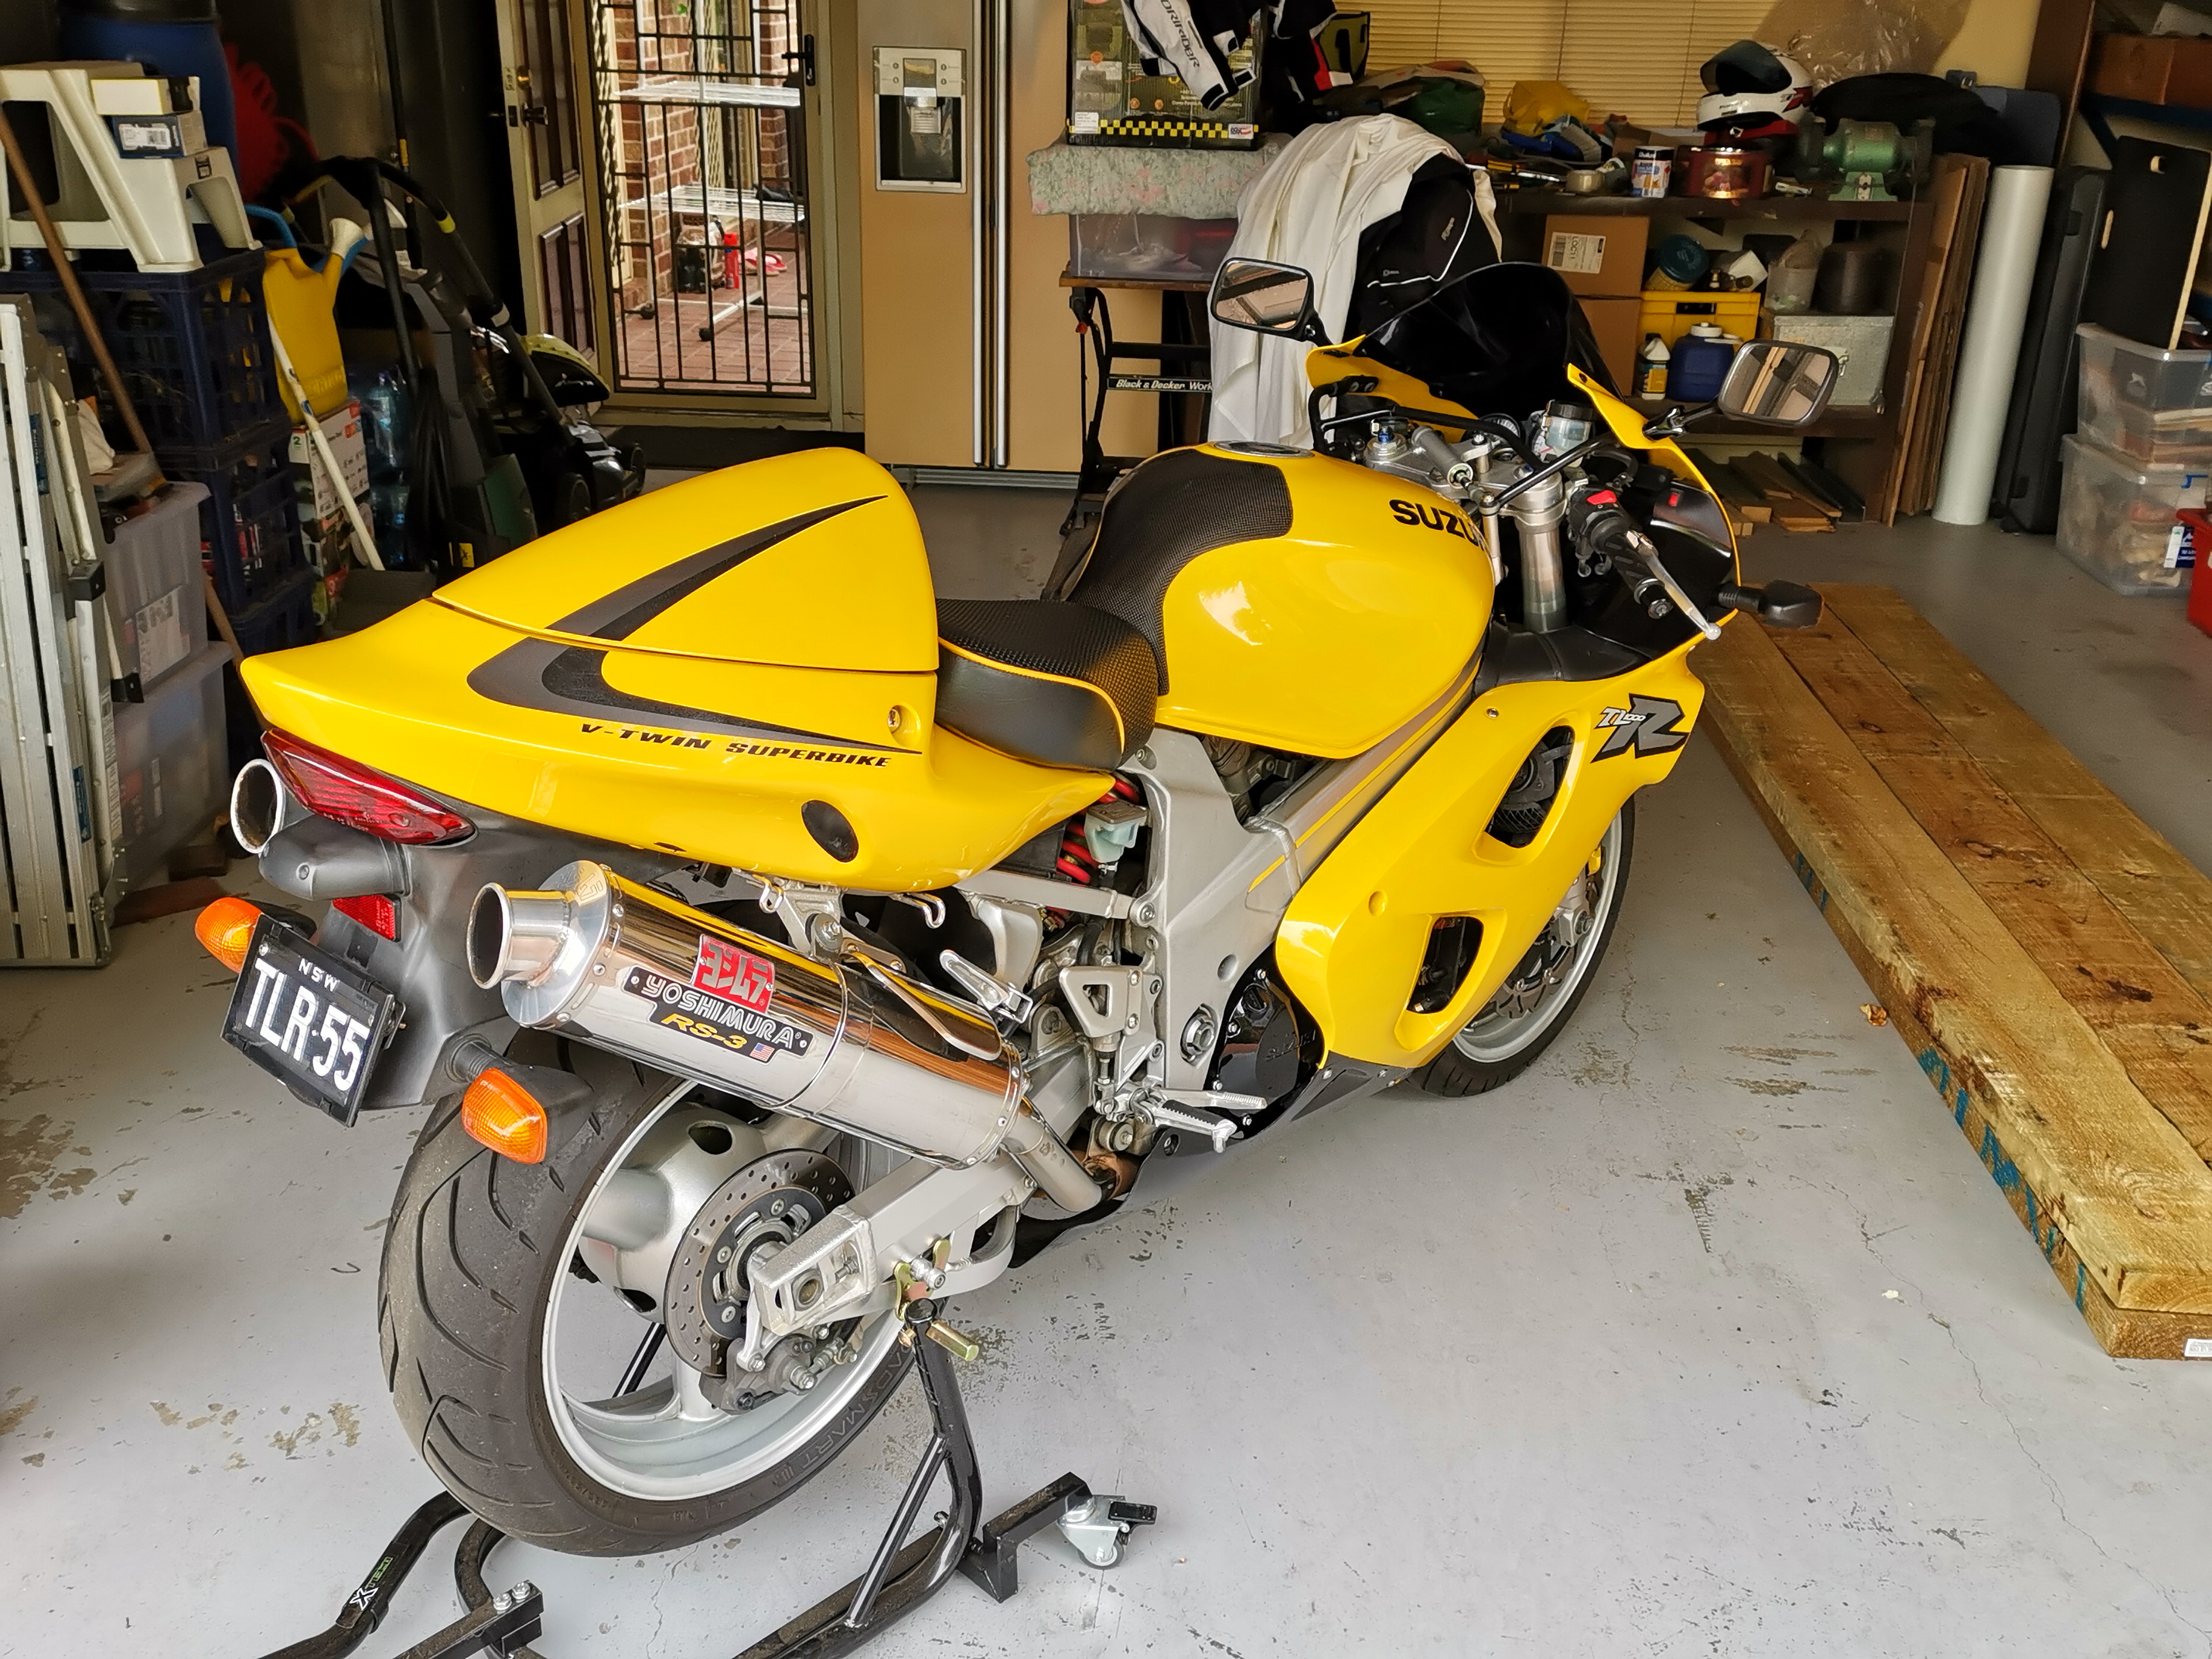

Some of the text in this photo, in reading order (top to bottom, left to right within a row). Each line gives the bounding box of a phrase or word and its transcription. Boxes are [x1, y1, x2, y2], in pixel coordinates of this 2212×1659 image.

[1116, 378, 1141, 388] Black
[1151, 380, 1185, 390] Decker
[1597, 706, 1647, 728] TL1000
[580, 723, 892, 767] V-TWIN SUPERBIKE
[298, 957, 341, 992] NSW
[640, 974, 796, 1050] YOSHIMURA
[661, 1013, 748, 1049] RS-3
